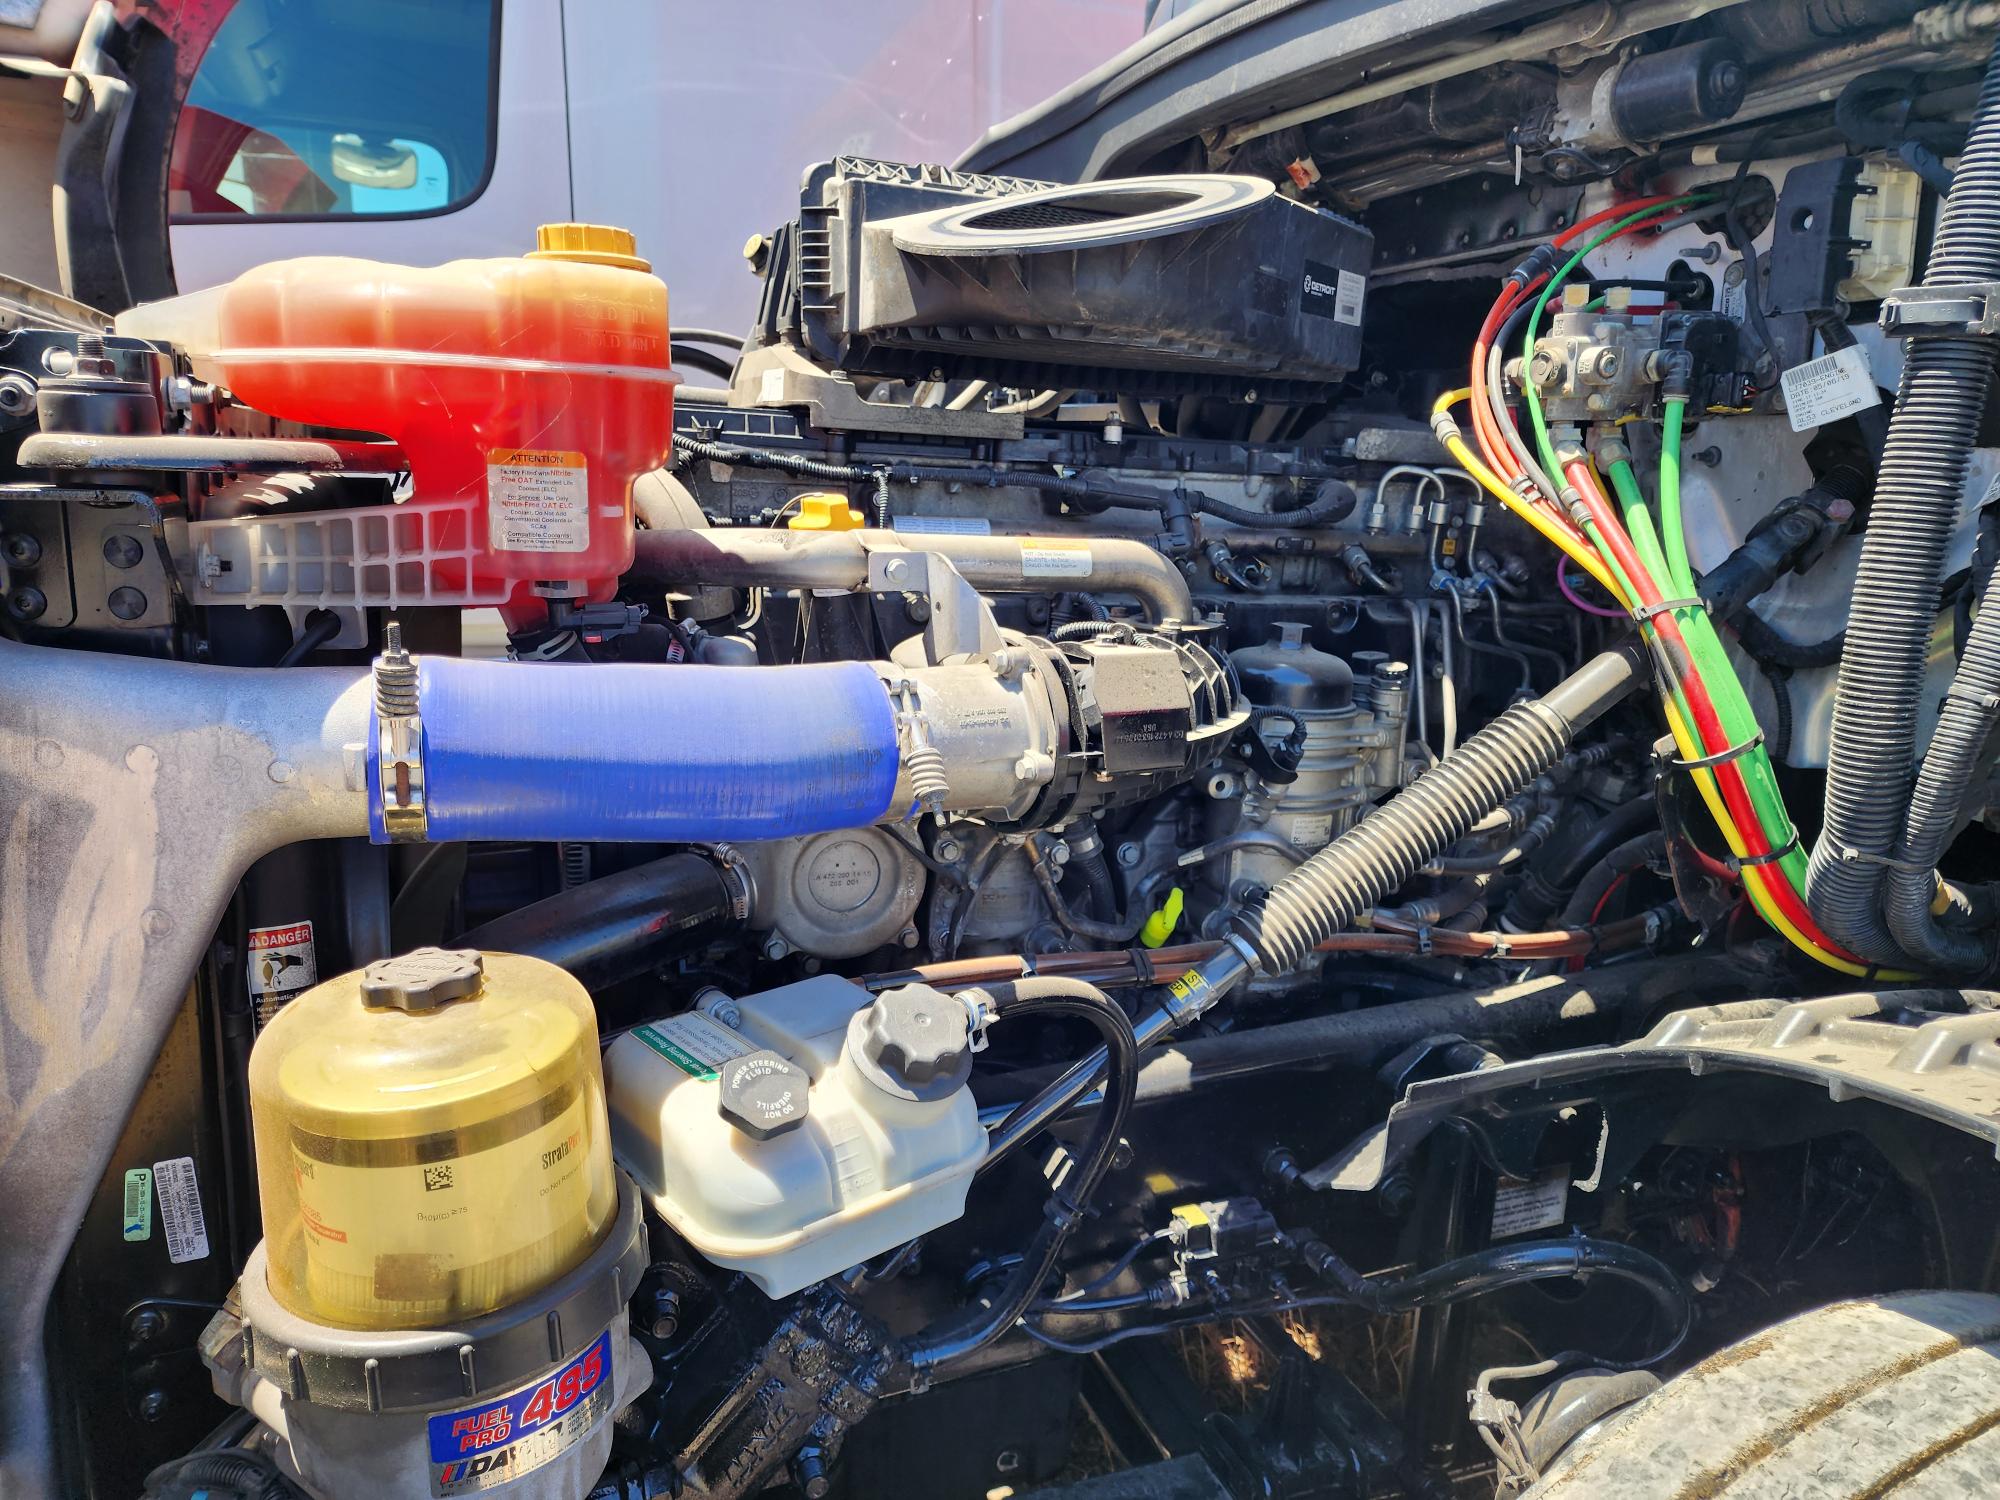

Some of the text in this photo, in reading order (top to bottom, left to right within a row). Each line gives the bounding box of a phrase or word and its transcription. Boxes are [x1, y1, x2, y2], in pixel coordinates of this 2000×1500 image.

[1311, 281, 1336, 296] DETROIT
[1820, 397, 1862, 416] CLEVELAND
[511, 454, 564, 463] ATTENTION
[501, 476, 517, 484] Free
[517, 477, 534, 485] OAT
[1142, 723, 1157, 733] USA
[261, 929, 310, 947] DANGER
[255, 993, 295, 1004] Automatic
[641, 1029, 670, 1051] Reservoir
[668, 1046, 694, 1066] Steering
[731, 1059, 789, 1089] POWER STEERING
[745, 1067, 772, 1081] FLUID
[756, 1091, 792, 1111] OVERFILL
[764, 1103, 794, 1119] DO NOT
[134, 1173, 147, 1182] P
[452, 1405, 514, 1438] FUEL
[519, 1344, 603, 1429] 485
[459, 1422, 512, 1453] PRO
